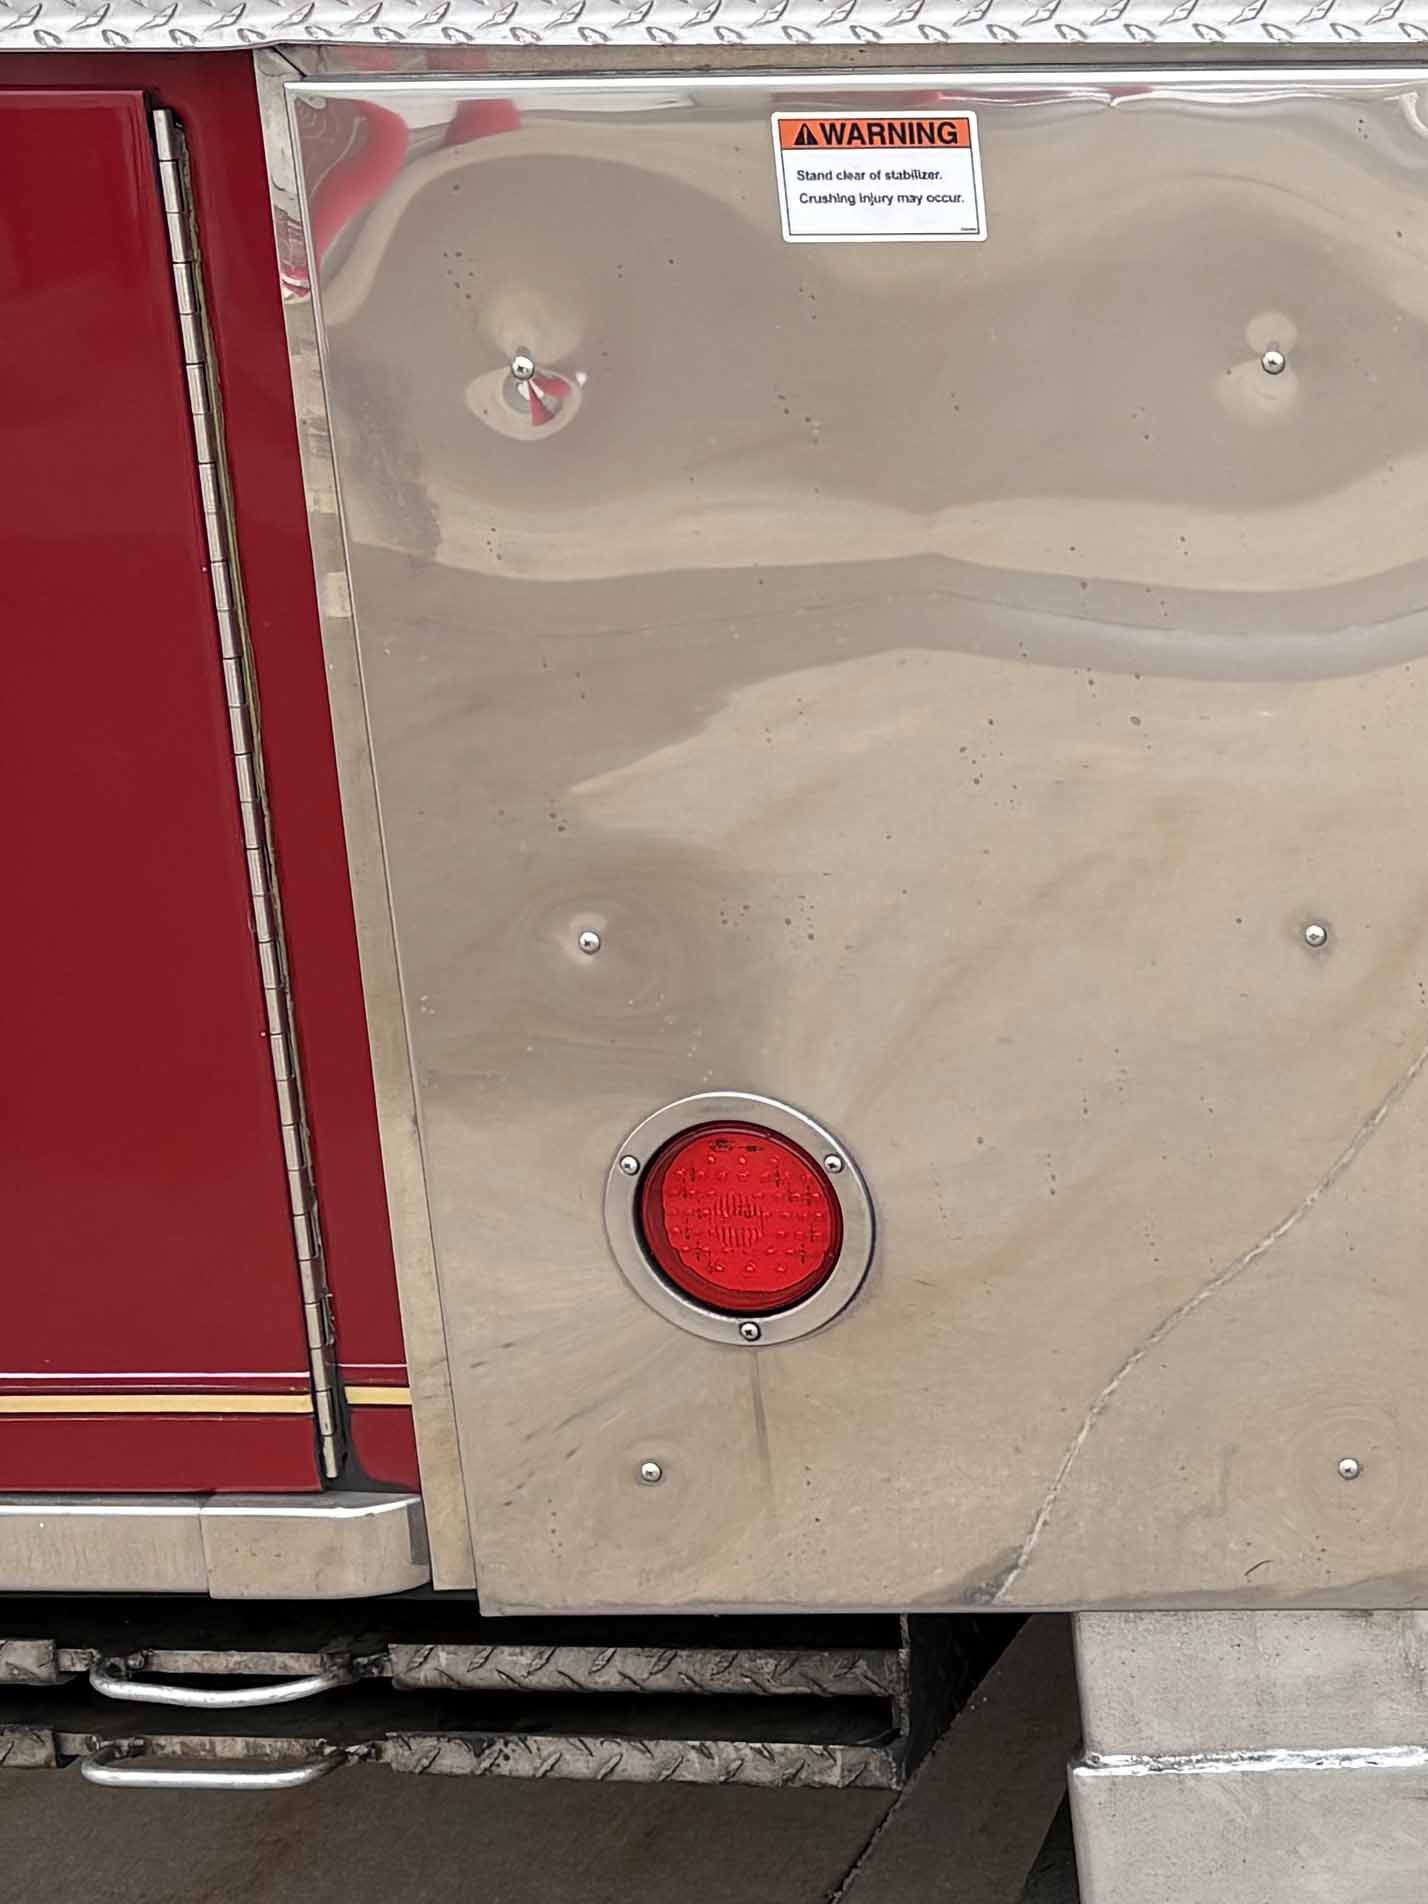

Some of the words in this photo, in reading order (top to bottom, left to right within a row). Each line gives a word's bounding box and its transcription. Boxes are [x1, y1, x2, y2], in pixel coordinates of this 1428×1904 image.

[819, 121, 959, 146] WARNING
[796, 169, 833, 181] Stand
[836, 169, 866, 181] clear
[869, 169, 881, 180] of
[884, 169, 943, 180] stabilizer.
[799, 192, 856, 205] Crushing
[859, 192, 894, 206] injury
[897, 194, 923, 206] may
[926, 193, 965, 204] occur.
